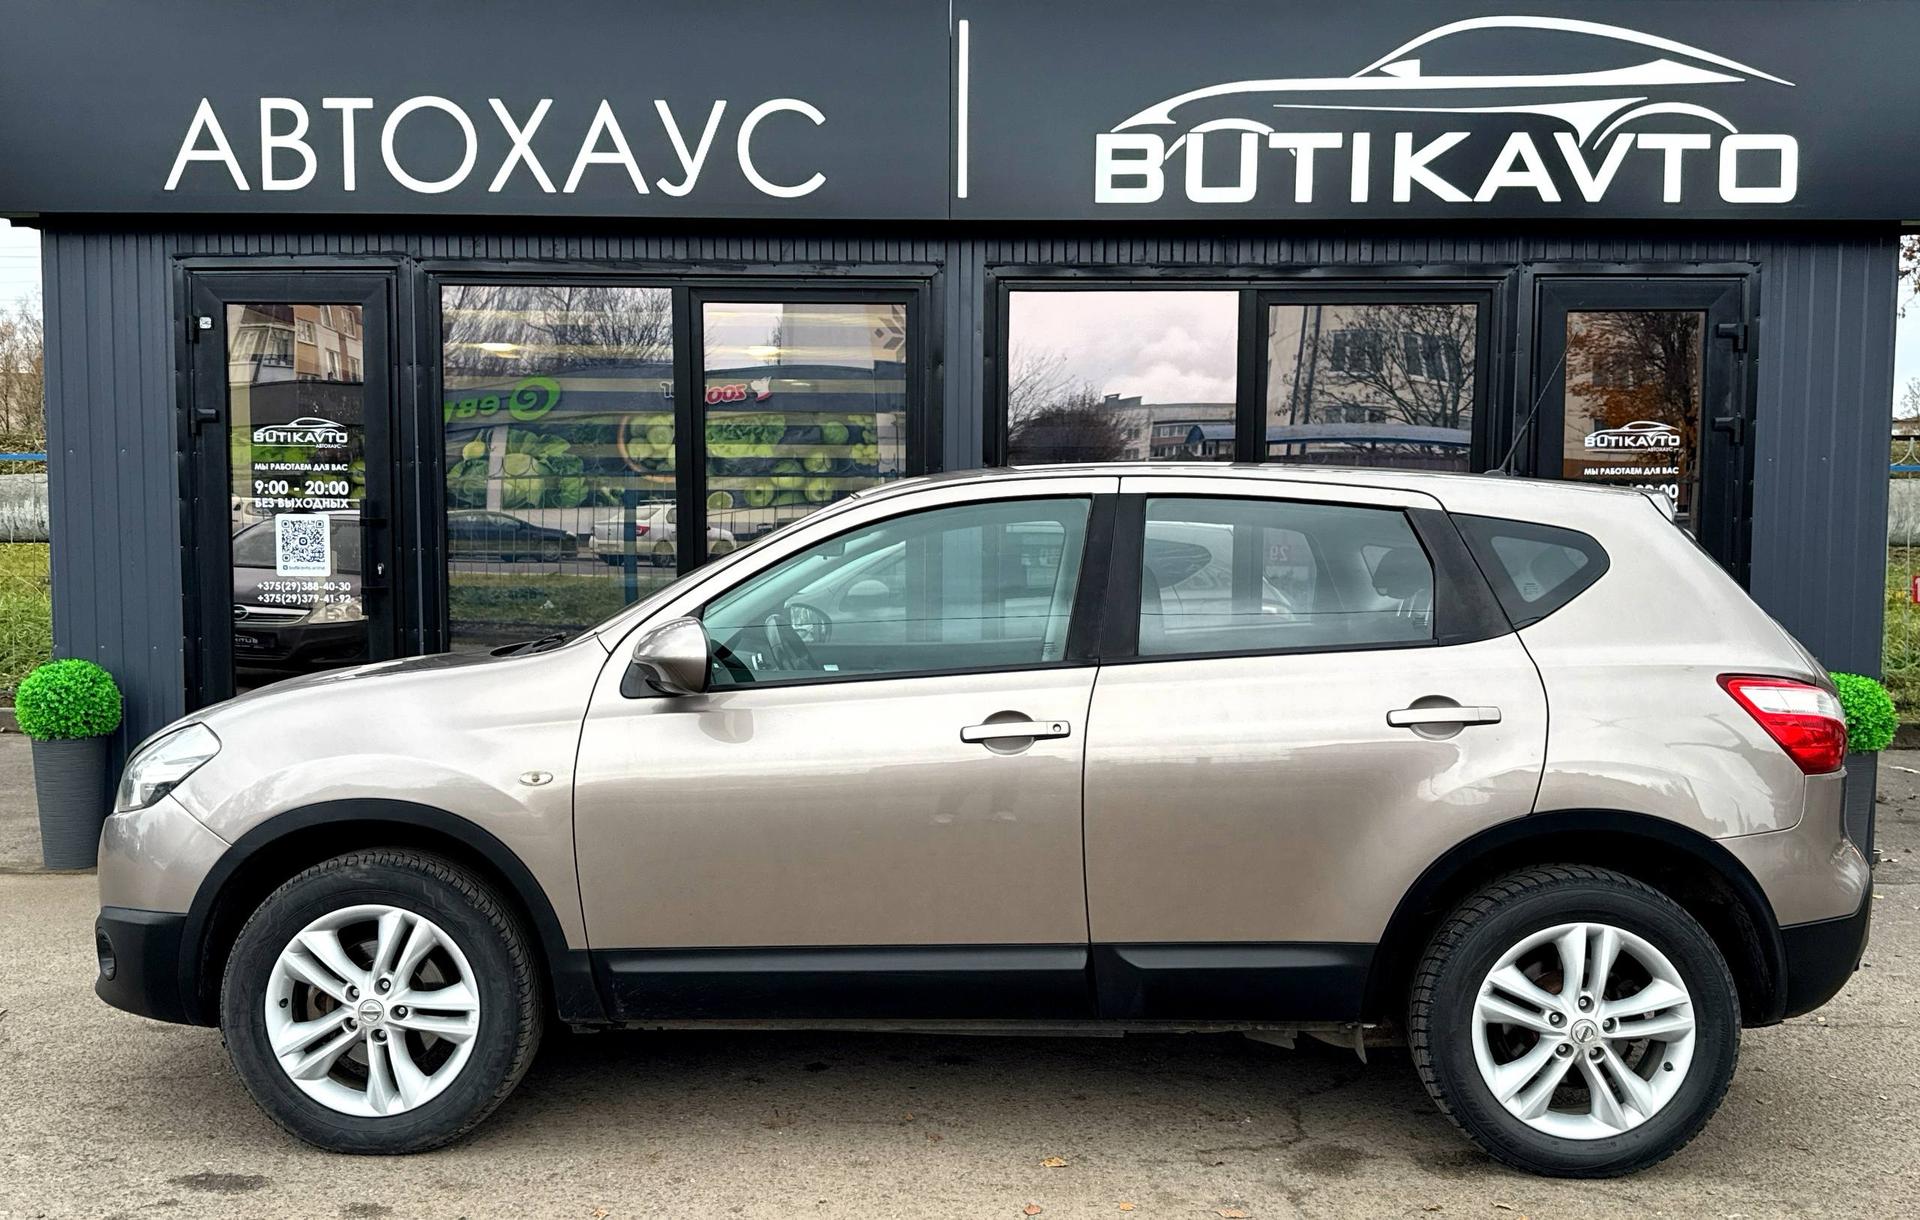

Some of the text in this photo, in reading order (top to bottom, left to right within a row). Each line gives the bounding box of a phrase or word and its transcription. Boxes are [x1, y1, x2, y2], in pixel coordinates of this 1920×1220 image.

[163, 95, 827, 199] АВТОХАУС
[1094, 131, 1800, 204] BUTIKAVTO
[253, 431, 348, 443] BUTIKAVTO
[1584, 435, 1681, 447] BUTIKAVTO
[254, 463, 348, 472] МЫ РАБОТАЕМ ДЛЯ ВАС
[1583, 466, 1680, 475] МЫ РАБОТАЕМ ДЛЯ ВАС
[254, 480, 289, 495] 9:00
[304, 480, 350, 496] 20:00
[254, 497, 349, 509] БЕЗ ВЫХОДНЫХ
[257, 582, 351, 592] +375(29)388-40-30
[257, 594, 352, 605] +375(29)379-41-92
